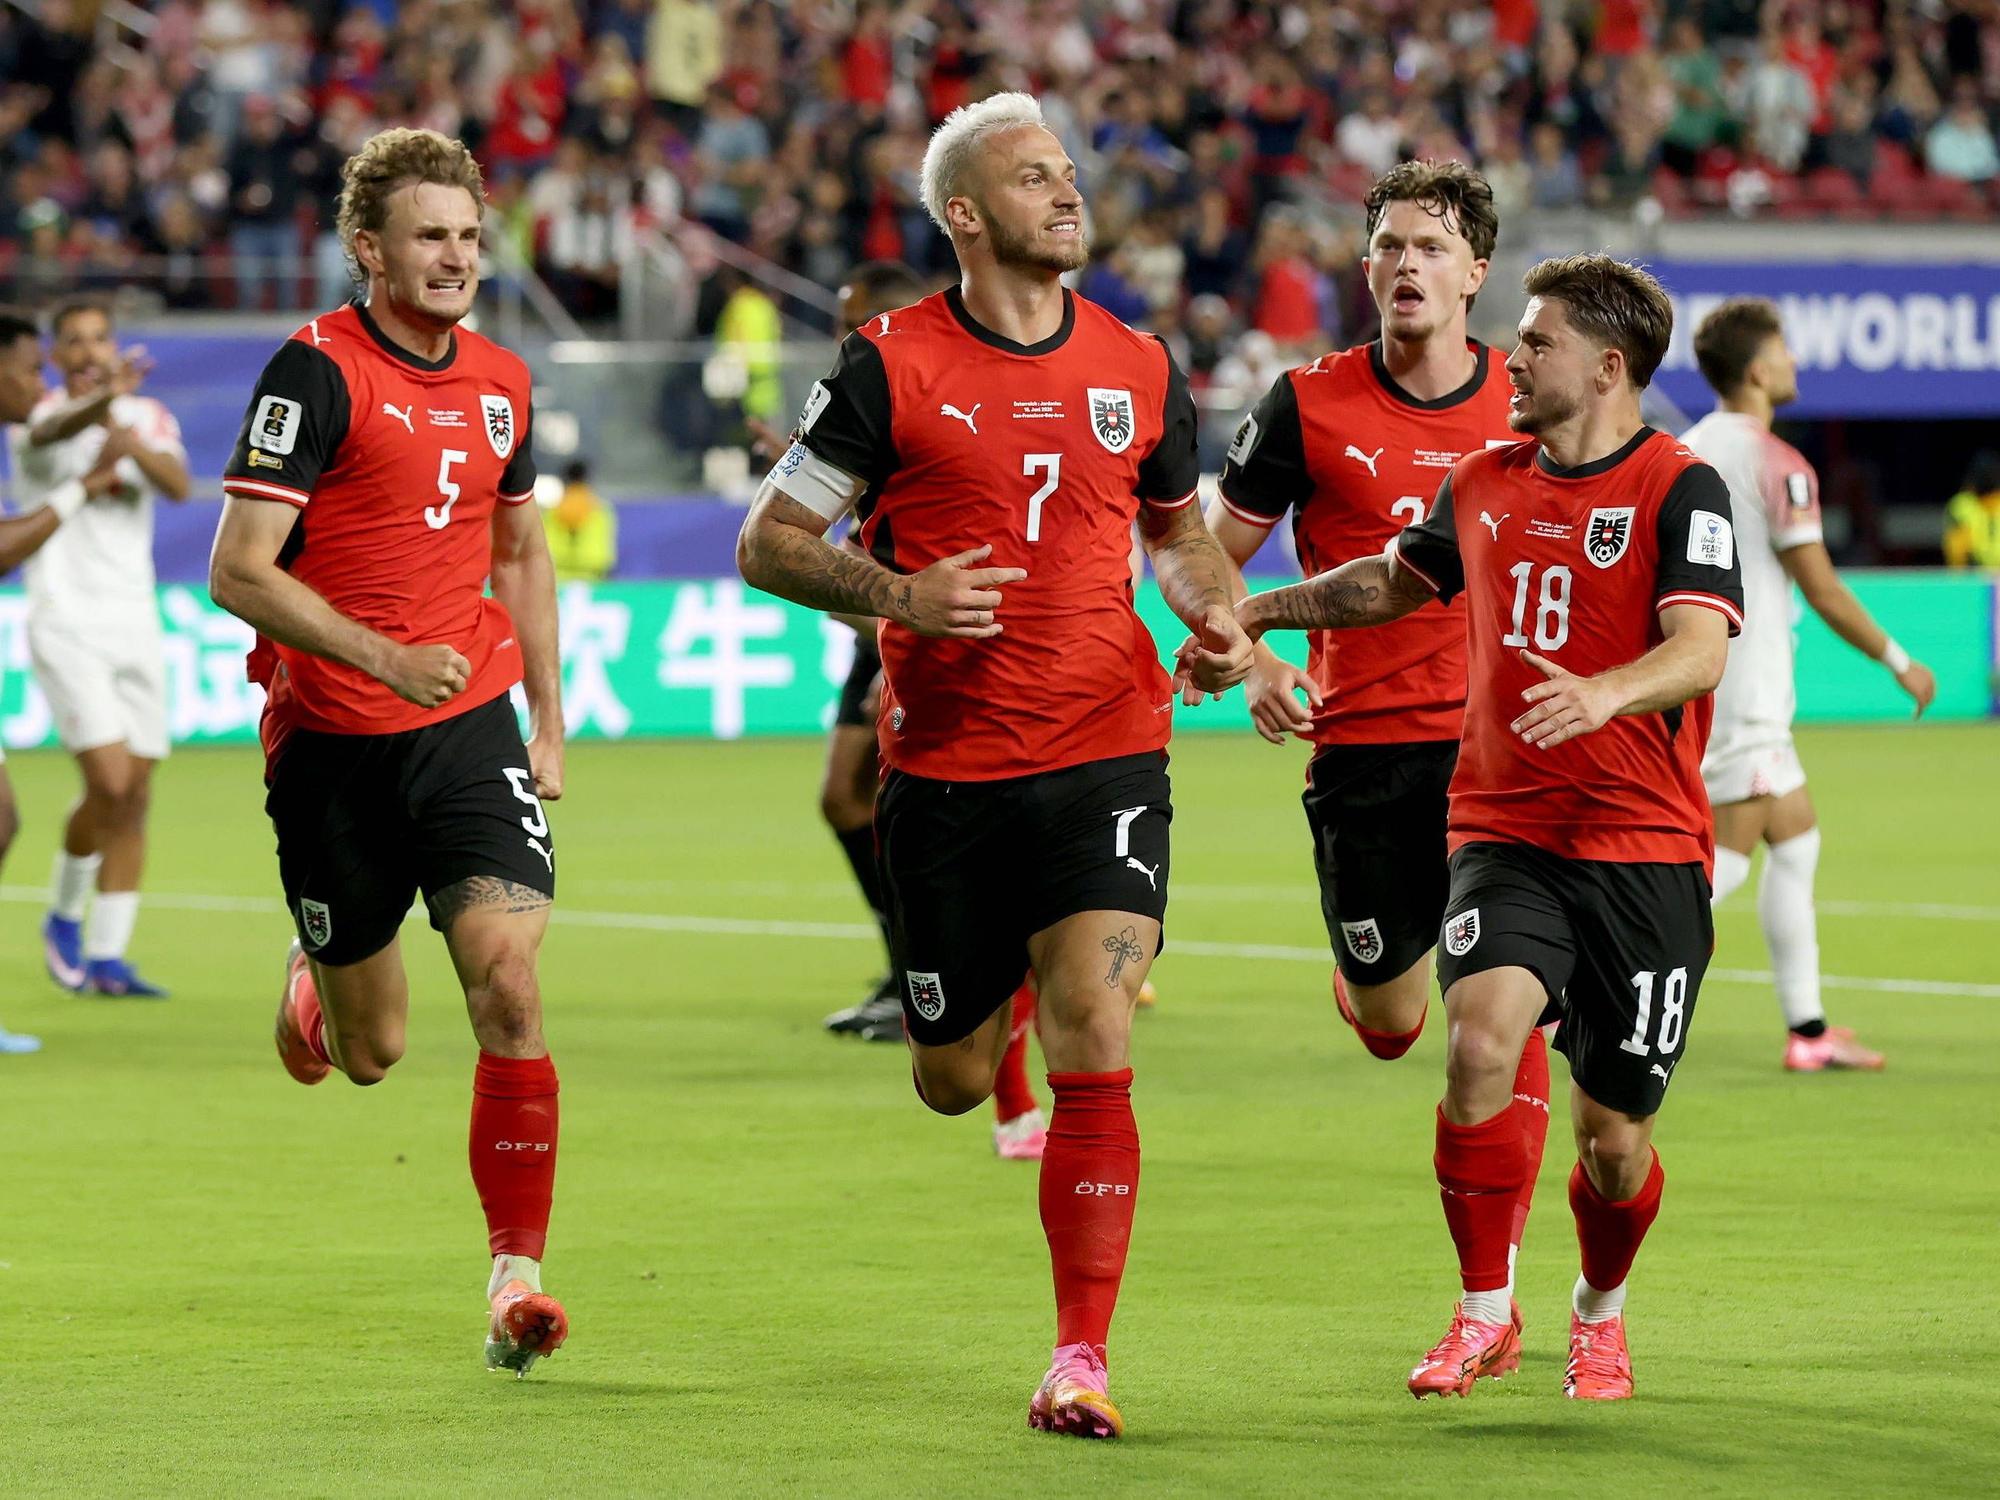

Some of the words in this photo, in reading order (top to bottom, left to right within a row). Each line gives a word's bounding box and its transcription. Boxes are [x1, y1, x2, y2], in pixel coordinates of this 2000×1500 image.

[1780, 292, 2000, 372] WORL
[424, 448, 469, 530] 5
[1022, 453, 1063, 543] 7
[1501, 560, 1573, 652] 18
[501, 766, 549, 839] 5
[1111, 804, 1148, 858] 7
[1619, 965, 1687, 1057] 18
[495, 1140, 549, 1152] ÖFB
[1074, 1181, 1130, 1197] ÖFB
